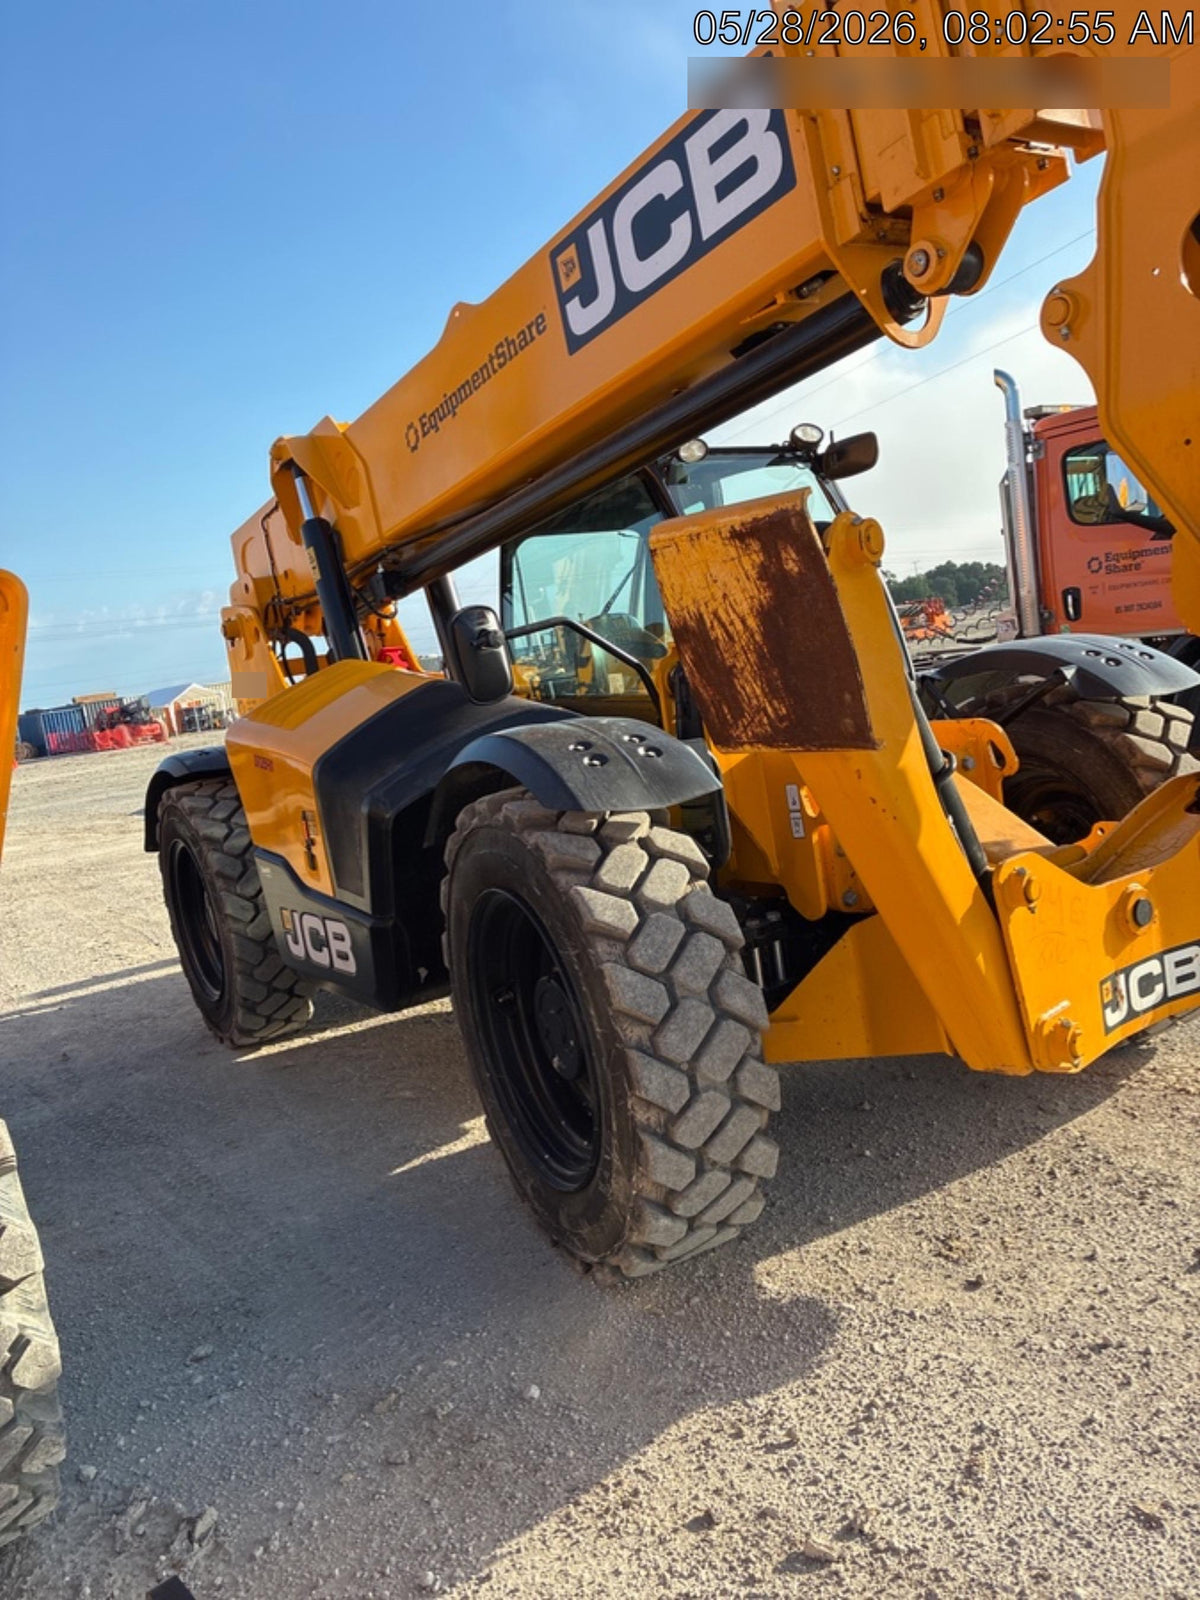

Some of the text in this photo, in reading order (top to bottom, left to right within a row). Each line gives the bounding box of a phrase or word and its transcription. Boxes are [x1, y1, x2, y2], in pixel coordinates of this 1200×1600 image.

[565, 109, 783, 336] JCB
[418, 312, 547, 439] EquipmentShare
[1105, 561, 1142, 574] Share
[286, 911, 356, 975] JCB
[1104, 945, 1200, 1027] JCB
